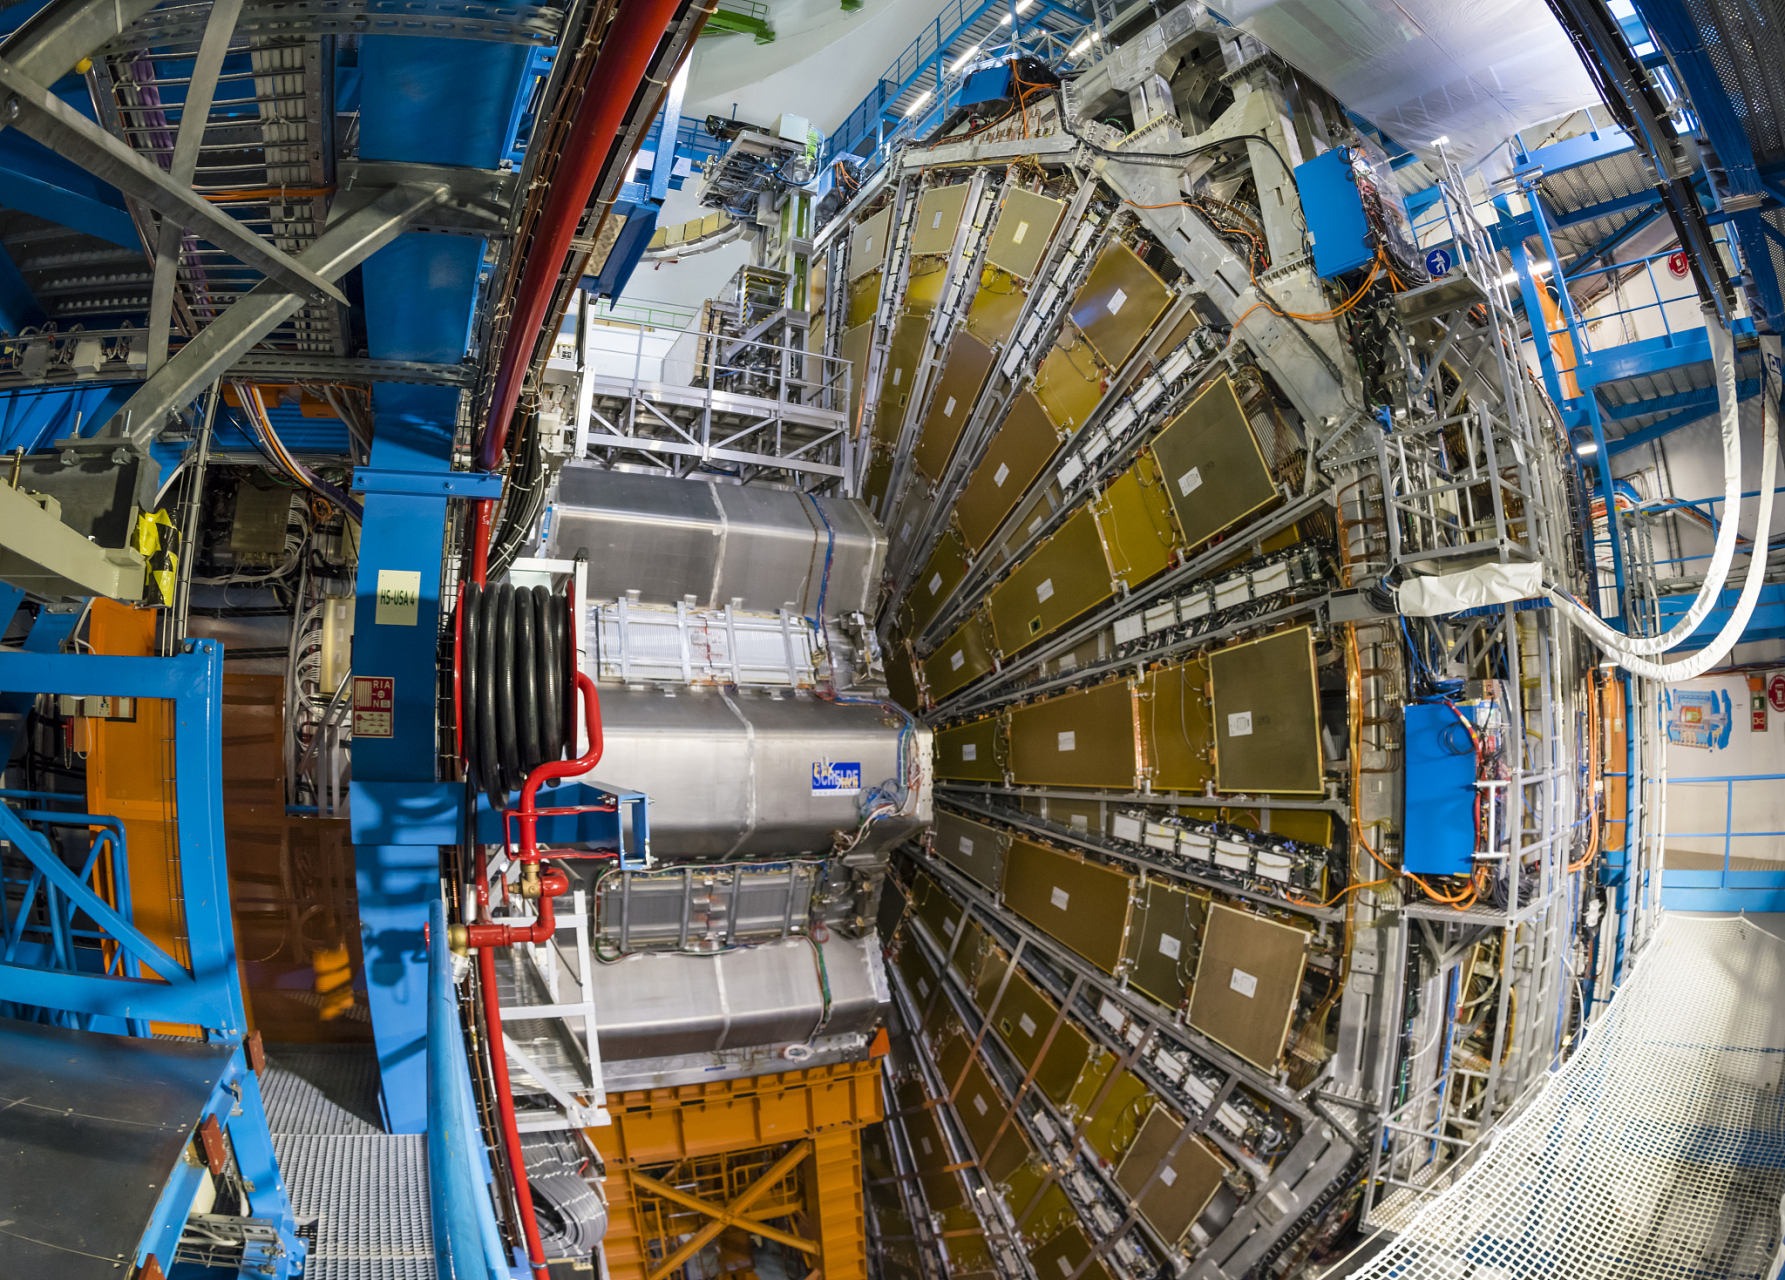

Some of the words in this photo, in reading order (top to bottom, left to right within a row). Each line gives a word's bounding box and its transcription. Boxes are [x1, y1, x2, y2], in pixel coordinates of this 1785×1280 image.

[380, 588, 409, 606] HS-USA
[410, 590, 415, 606] 4
[373, 680, 391, 689] RIA
